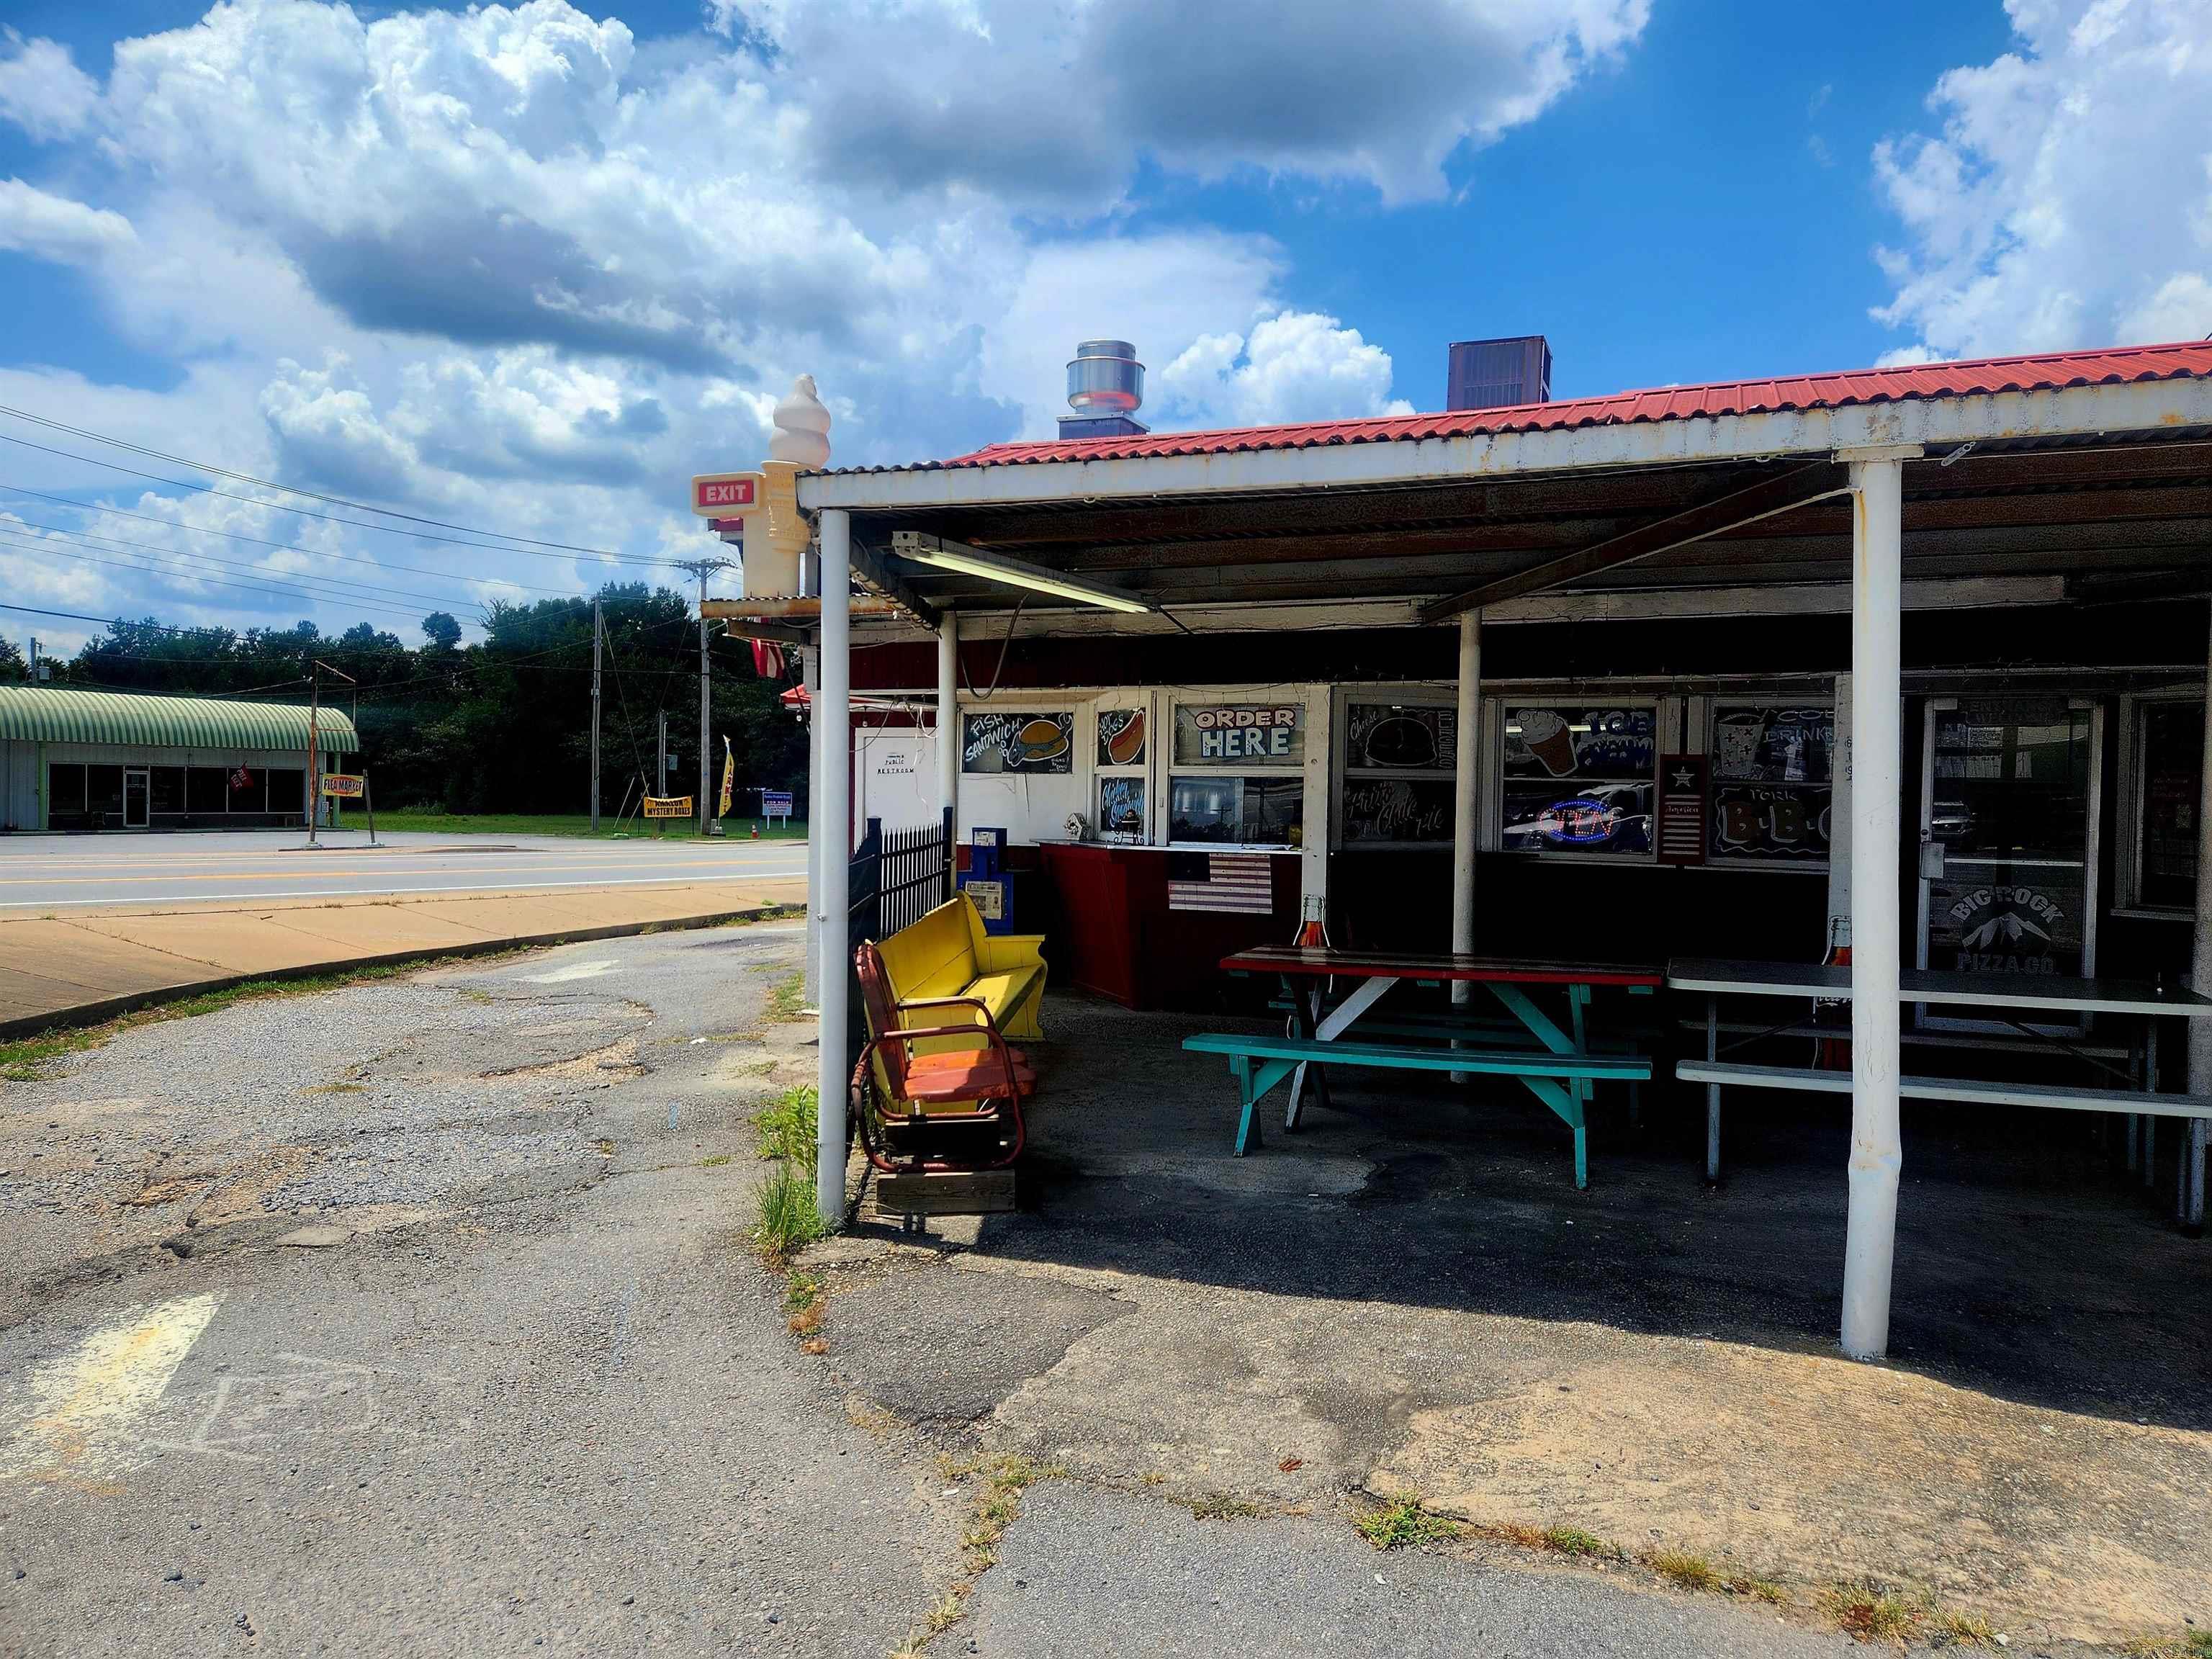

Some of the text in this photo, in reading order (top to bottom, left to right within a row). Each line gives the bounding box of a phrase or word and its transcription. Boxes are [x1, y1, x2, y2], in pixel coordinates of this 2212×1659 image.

[706, 485, 746, 502] EXIT
[971, 714, 1004, 736] FISH
[1099, 713, 1113, 736] HOT
[1195, 708, 1296, 729] ORDER
[1349, 709, 1379, 741] Cheese
[1583, 711, 1650, 737] ICE
[965, 719, 1020, 762] SANDWICH
[1201, 727, 1290, 757] HERE
[323, 778, 363, 793] FLEA MARKET
[647, 806, 691, 816] MYSTERY BOXES
[1537, 806, 1614, 835] OPEN
[1949, 886, 2065, 923] BIG ROCK
[1956, 952, 2020, 974] PIZZA
